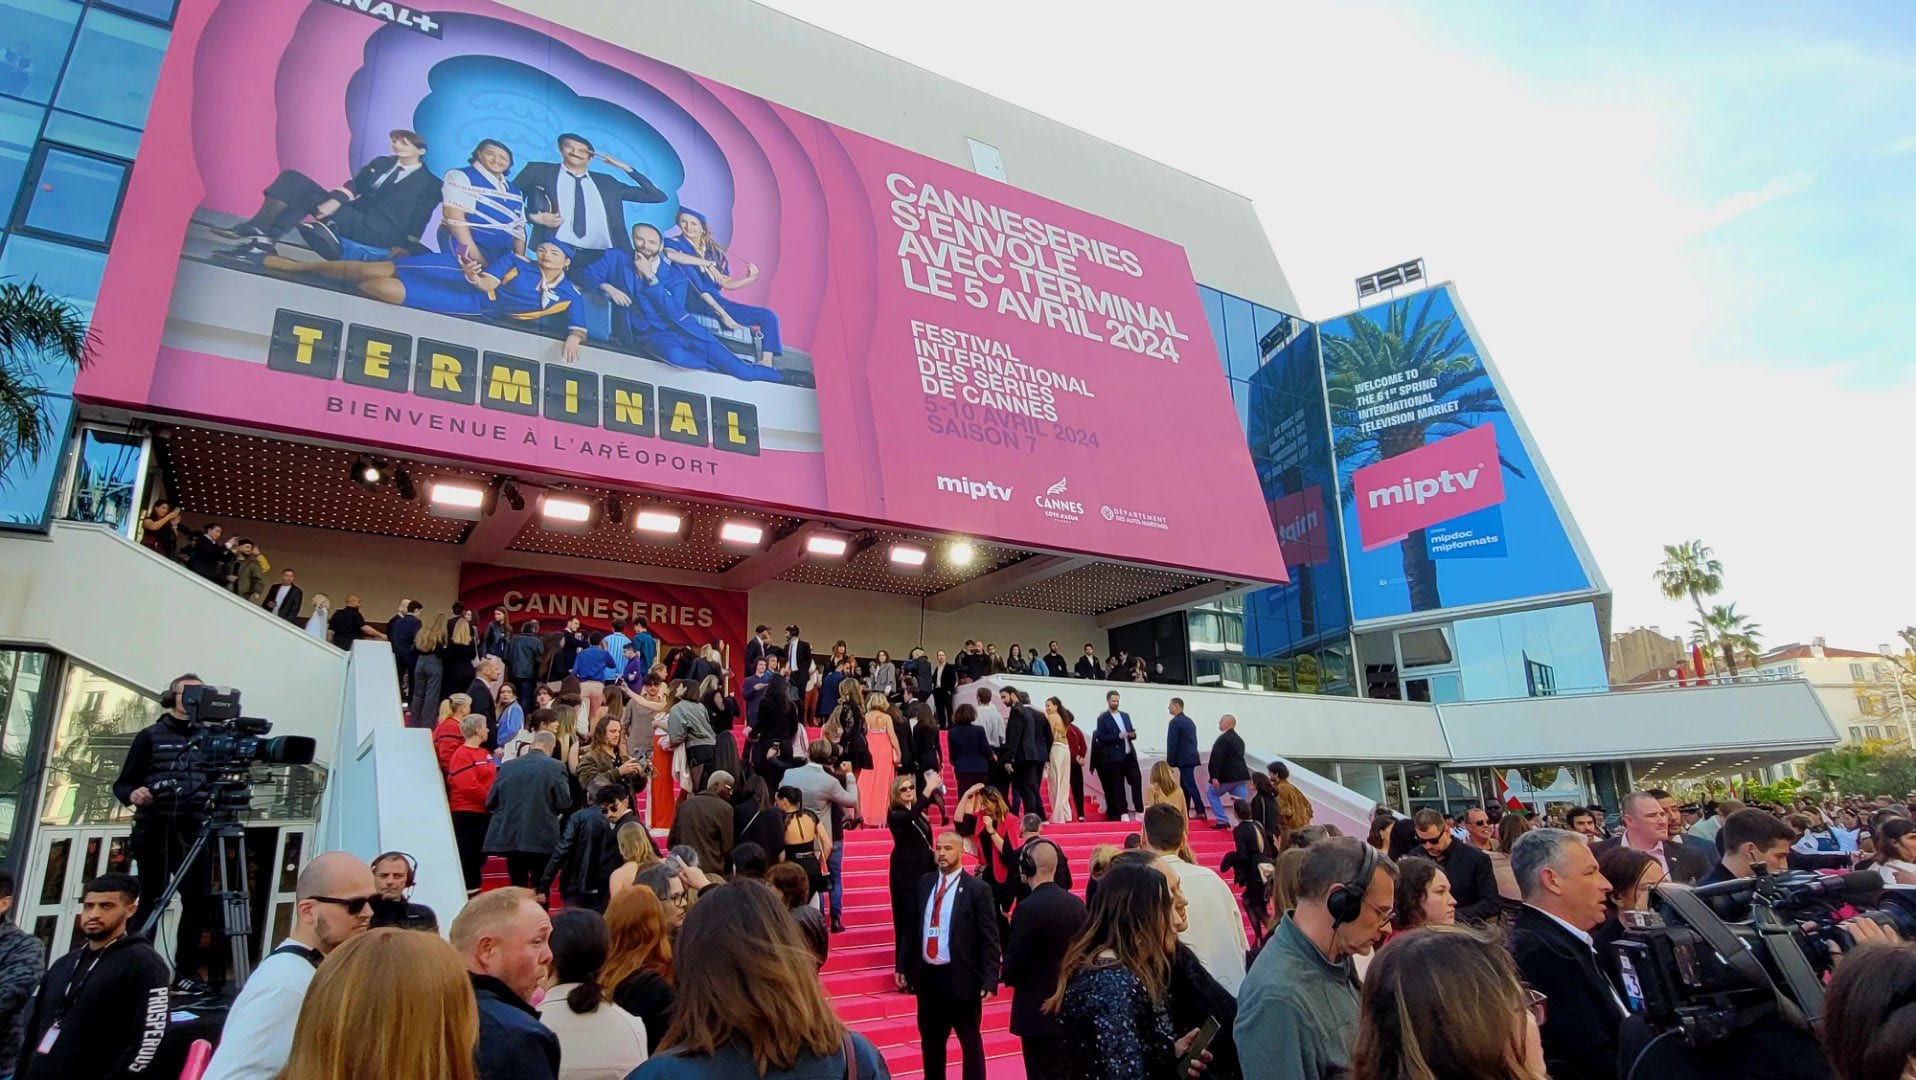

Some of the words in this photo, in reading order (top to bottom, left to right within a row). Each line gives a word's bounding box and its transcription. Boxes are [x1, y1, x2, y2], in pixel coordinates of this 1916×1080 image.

[333, 0, 438, 32] NAL+
[886, 173, 1143, 278] CANNESERIES
[891, 200, 1080, 282] S'ENVOLE
[897, 231, 1004, 284] AVEC
[1009, 262, 1189, 341] TERMINAL
[901, 258, 956, 301] LE
[964, 277, 988, 309] 5
[997, 287, 1103, 342] AVRIL
[1105, 319, 1180, 363] 2024
[911, 319, 1020, 362] FESTIVAL
[293, 325, 746, 445] TERMINAL
[914, 338, 1094, 398] INTERNATIONAL
[917, 356, 968, 384] DES
[973, 370, 1055, 404] SÉRIES
[1354, 372, 1404, 394] WELCOME
[1405, 368, 1418, 380] TO
[921, 375, 956, 400] DE
[962, 385, 1059, 422] CANNES
[1356, 395, 1375, 406] THE
[1399, 378, 1437, 396] SPRING
[1358, 392, 1435, 420] INTERNATIONAL
[326, 396, 507, 441] BIENVENUE
[522, 428, 537, 446] À
[924, 396, 975, 421] 5-10
[983, 408, 1049, 437] AVRIL
[1051, 424, 1100, 448] 2024
[927, 415, 1019, 450] SAISON
[1024, 435, 1037, 453] 7
[1360, 411, 1415, 433] TELEVISION
[1417, 400, 1459, 419] MARKET
[937, 476, 1012, 501] miptv
[1035, 495, 1084, 514] CANNES
[1368, 467, 1480, 508] miptv
[1431, 529, 1473, 544] mipdoc
[1432, 535, 1499, 553] mipformats
[503, 590, 713, 628] CANNESERIES
[128, 986, 169, 1072] PROSPEROUS
